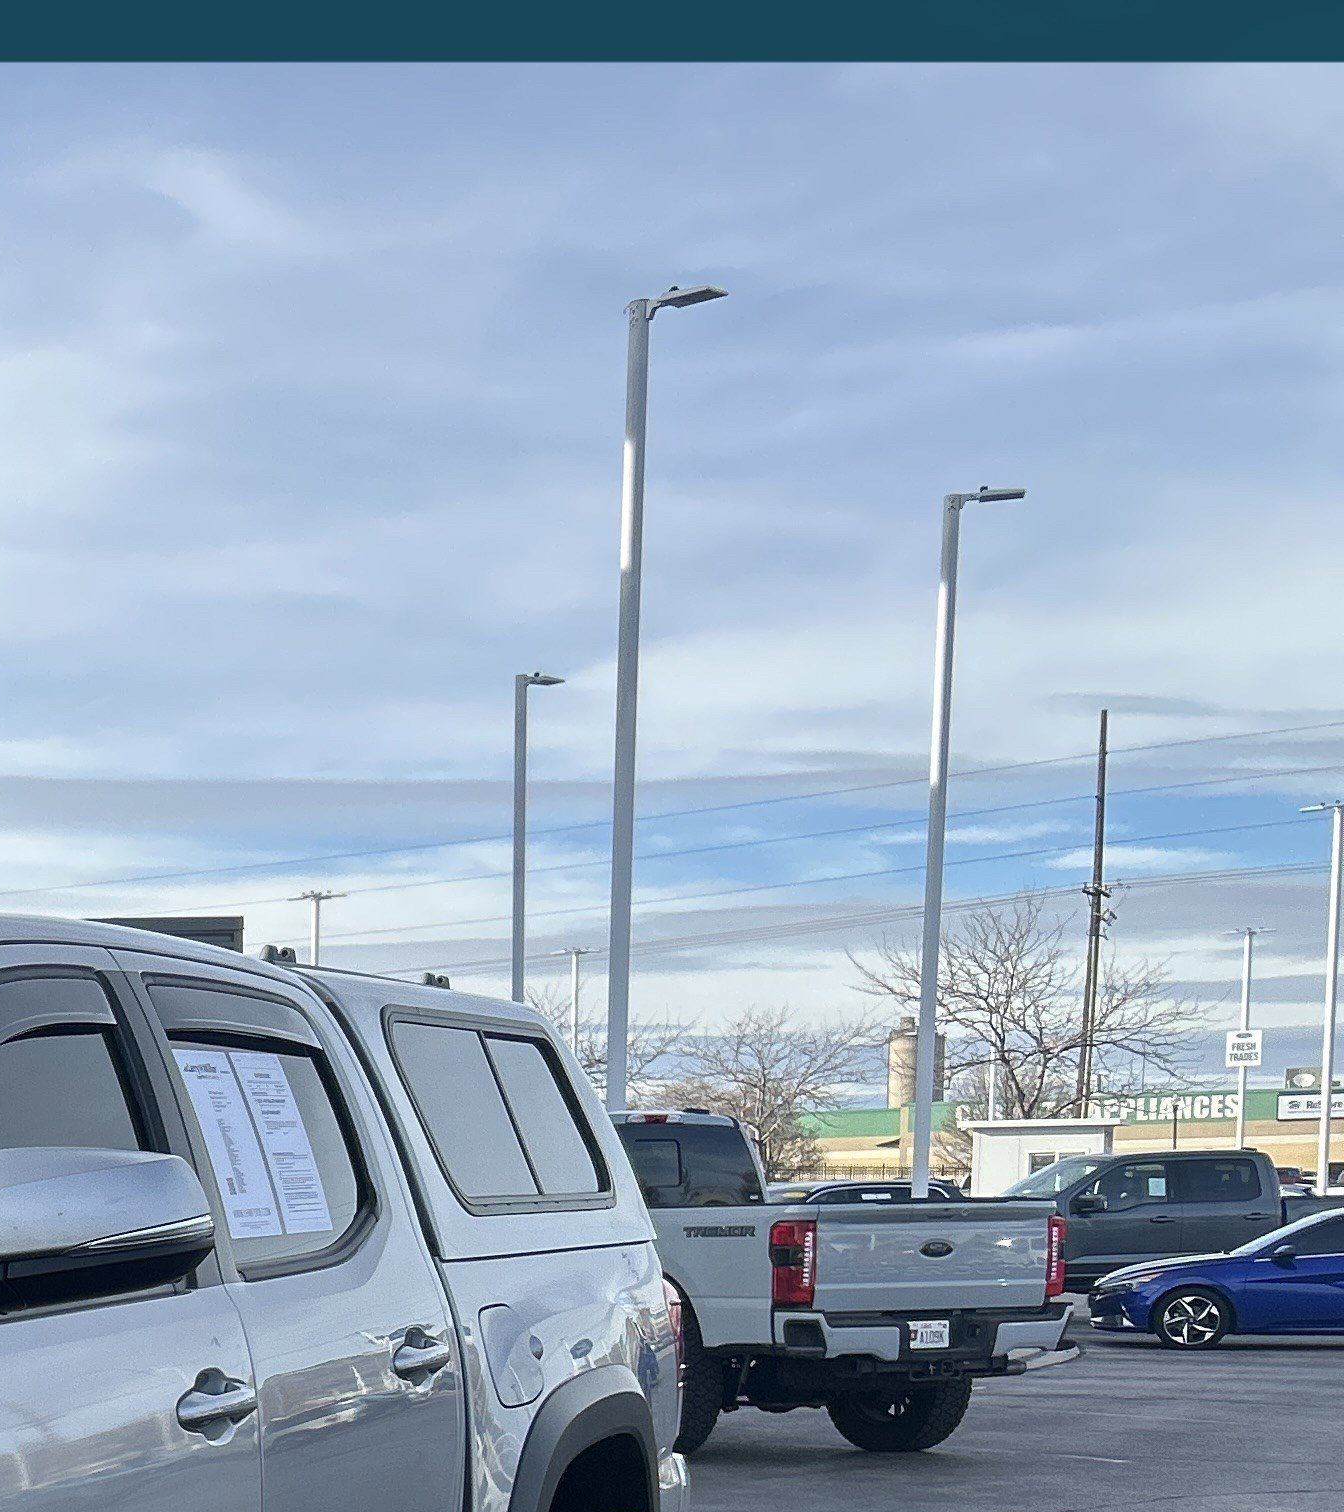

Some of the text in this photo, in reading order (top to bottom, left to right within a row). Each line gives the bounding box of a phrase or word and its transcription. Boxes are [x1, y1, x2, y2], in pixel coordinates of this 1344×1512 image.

[1231, 1042, 1256, 1051] FRESH
[1087, 1093, 1238, 1122] APPLIANCES
[683, 1226, 755, 1238] TREMOR
